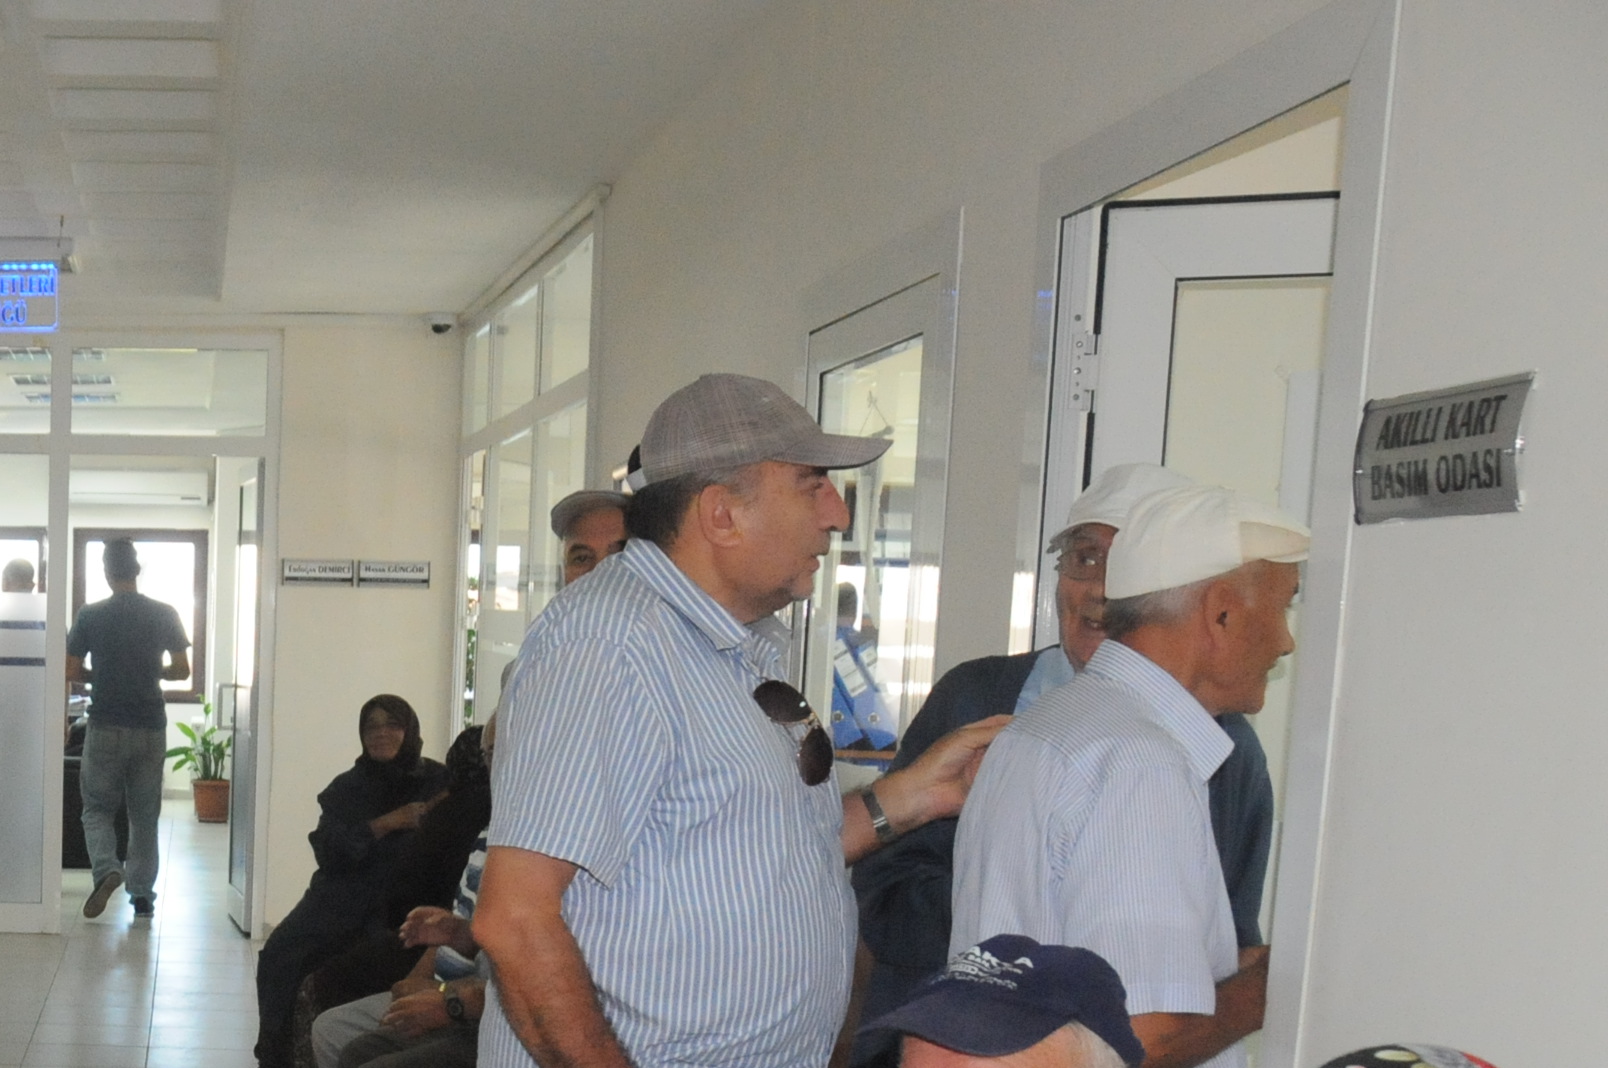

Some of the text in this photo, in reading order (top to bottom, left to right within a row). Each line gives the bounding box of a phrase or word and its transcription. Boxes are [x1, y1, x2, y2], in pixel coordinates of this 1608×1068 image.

[1375, 394, 1508, 451] AKILLI KART
[1370, 448, 1502, 501] BASIM ODASI
